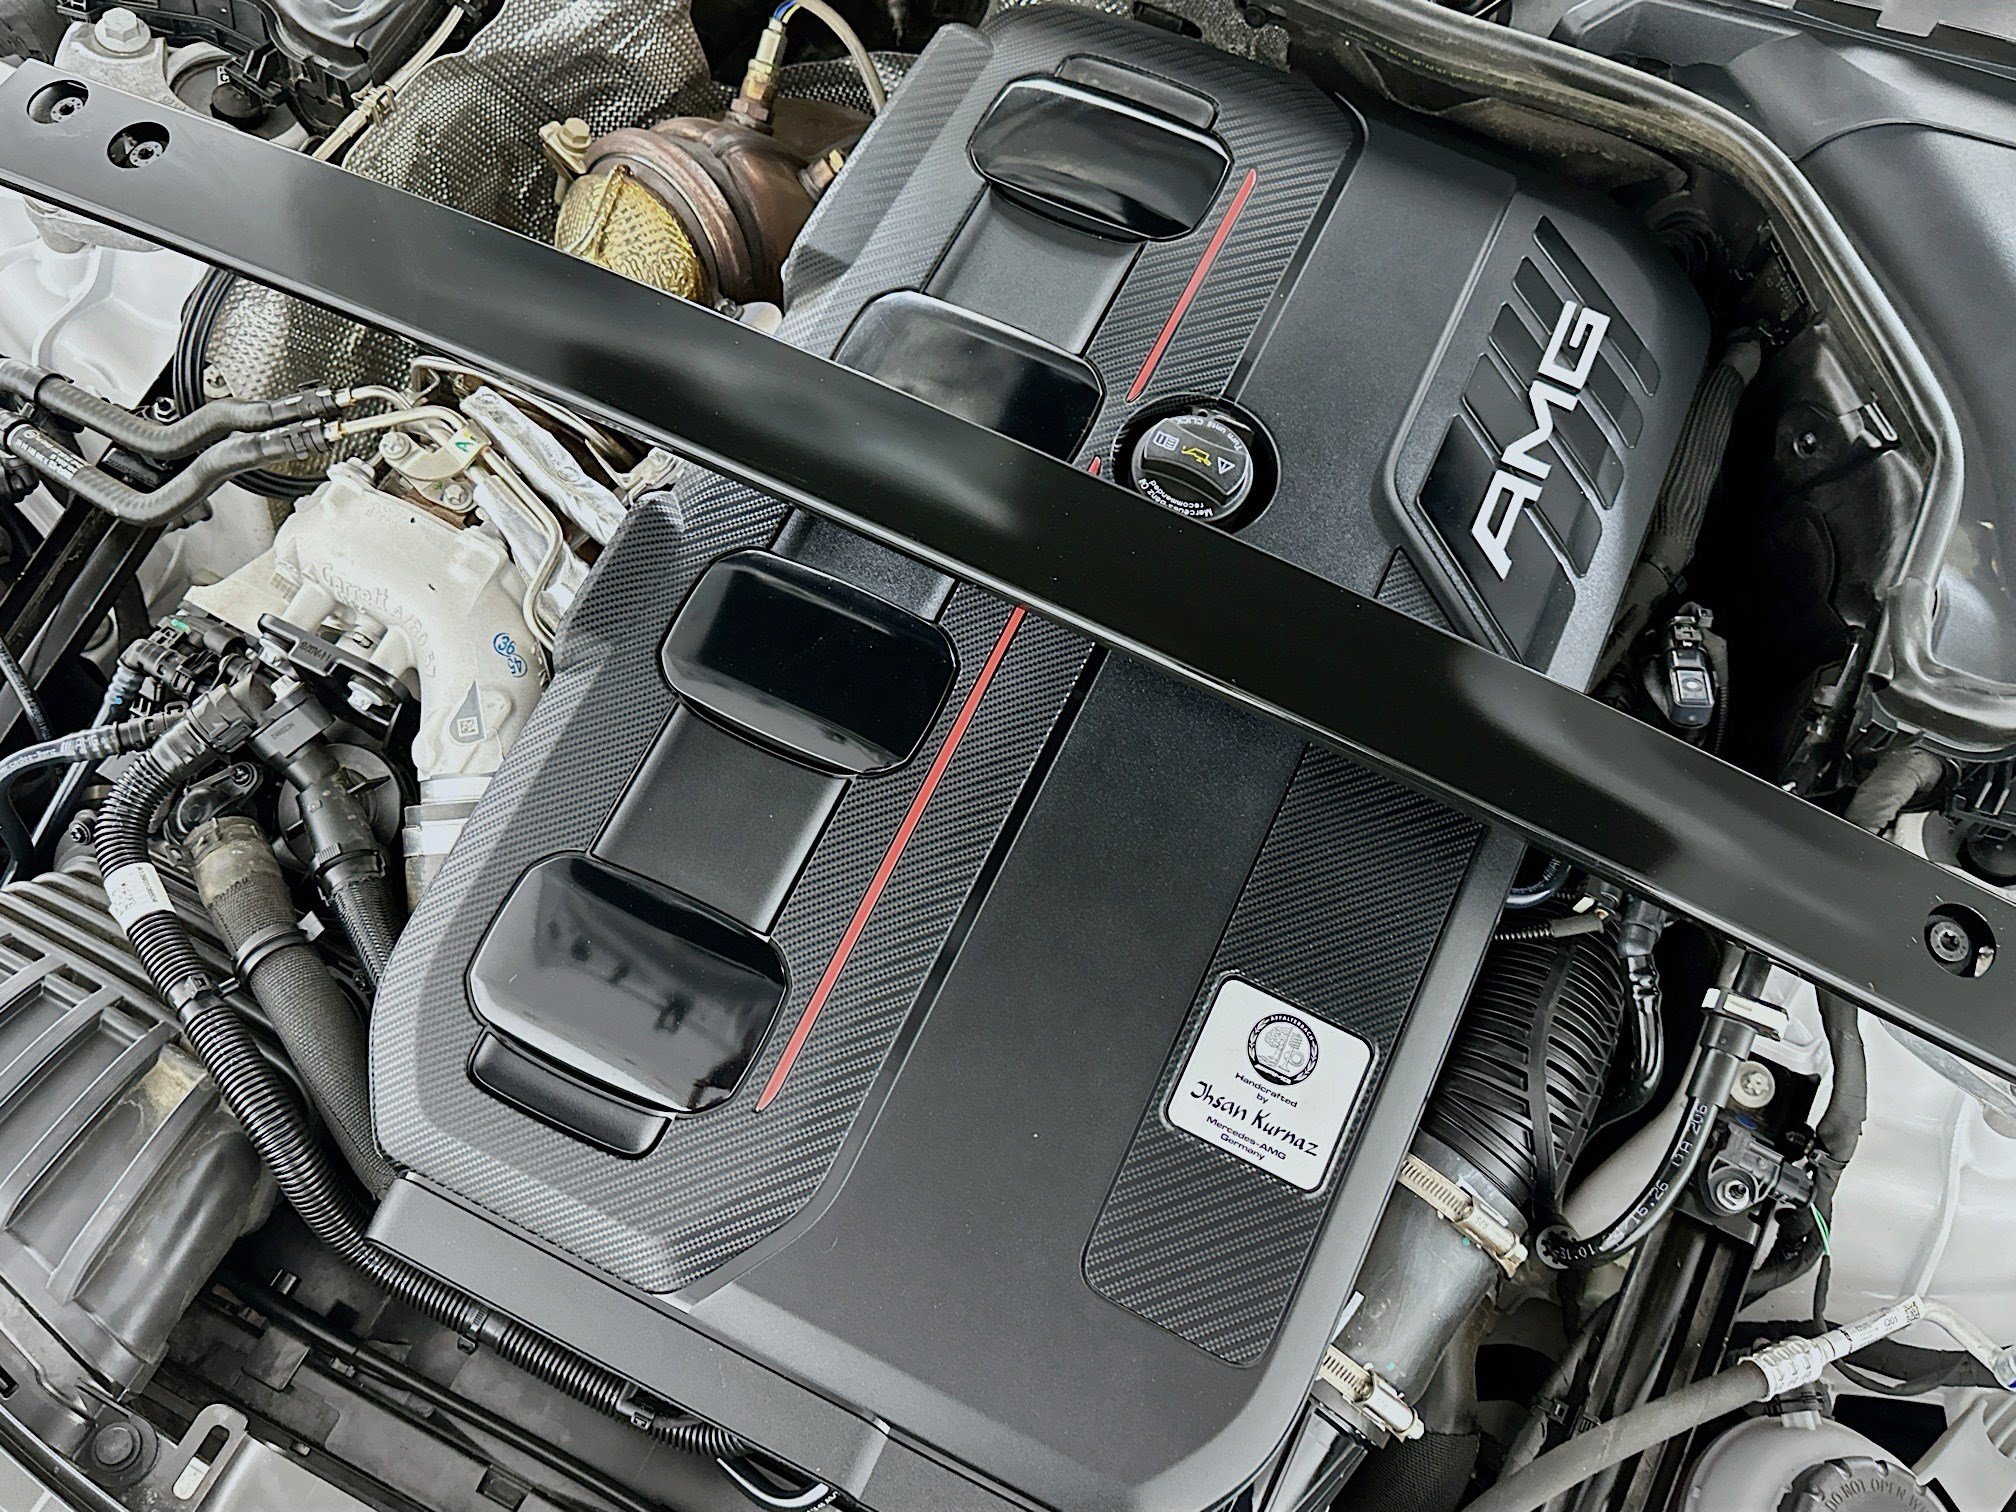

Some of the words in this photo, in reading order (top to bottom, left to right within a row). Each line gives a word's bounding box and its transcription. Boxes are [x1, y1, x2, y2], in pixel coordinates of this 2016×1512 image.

[1206, 420, 1227, 435] until
[1226, 428, 1243, 451] Turn
[1472, 300, 1611, 580] AMG
[1148, 479, 1206, 509] recommended
[1235, 1072, 1298, 1108] Handcrafted
[1256, 1092, 1269, 1104] by
[1206, 1115, 1287, 1161] Mercedes-AMG
[1220, 1133, 1265, 1161] Germany
[1251, 1109, 1319, 1157] Kurnaz
[1841, 1479, 1866, 1499] NOT
